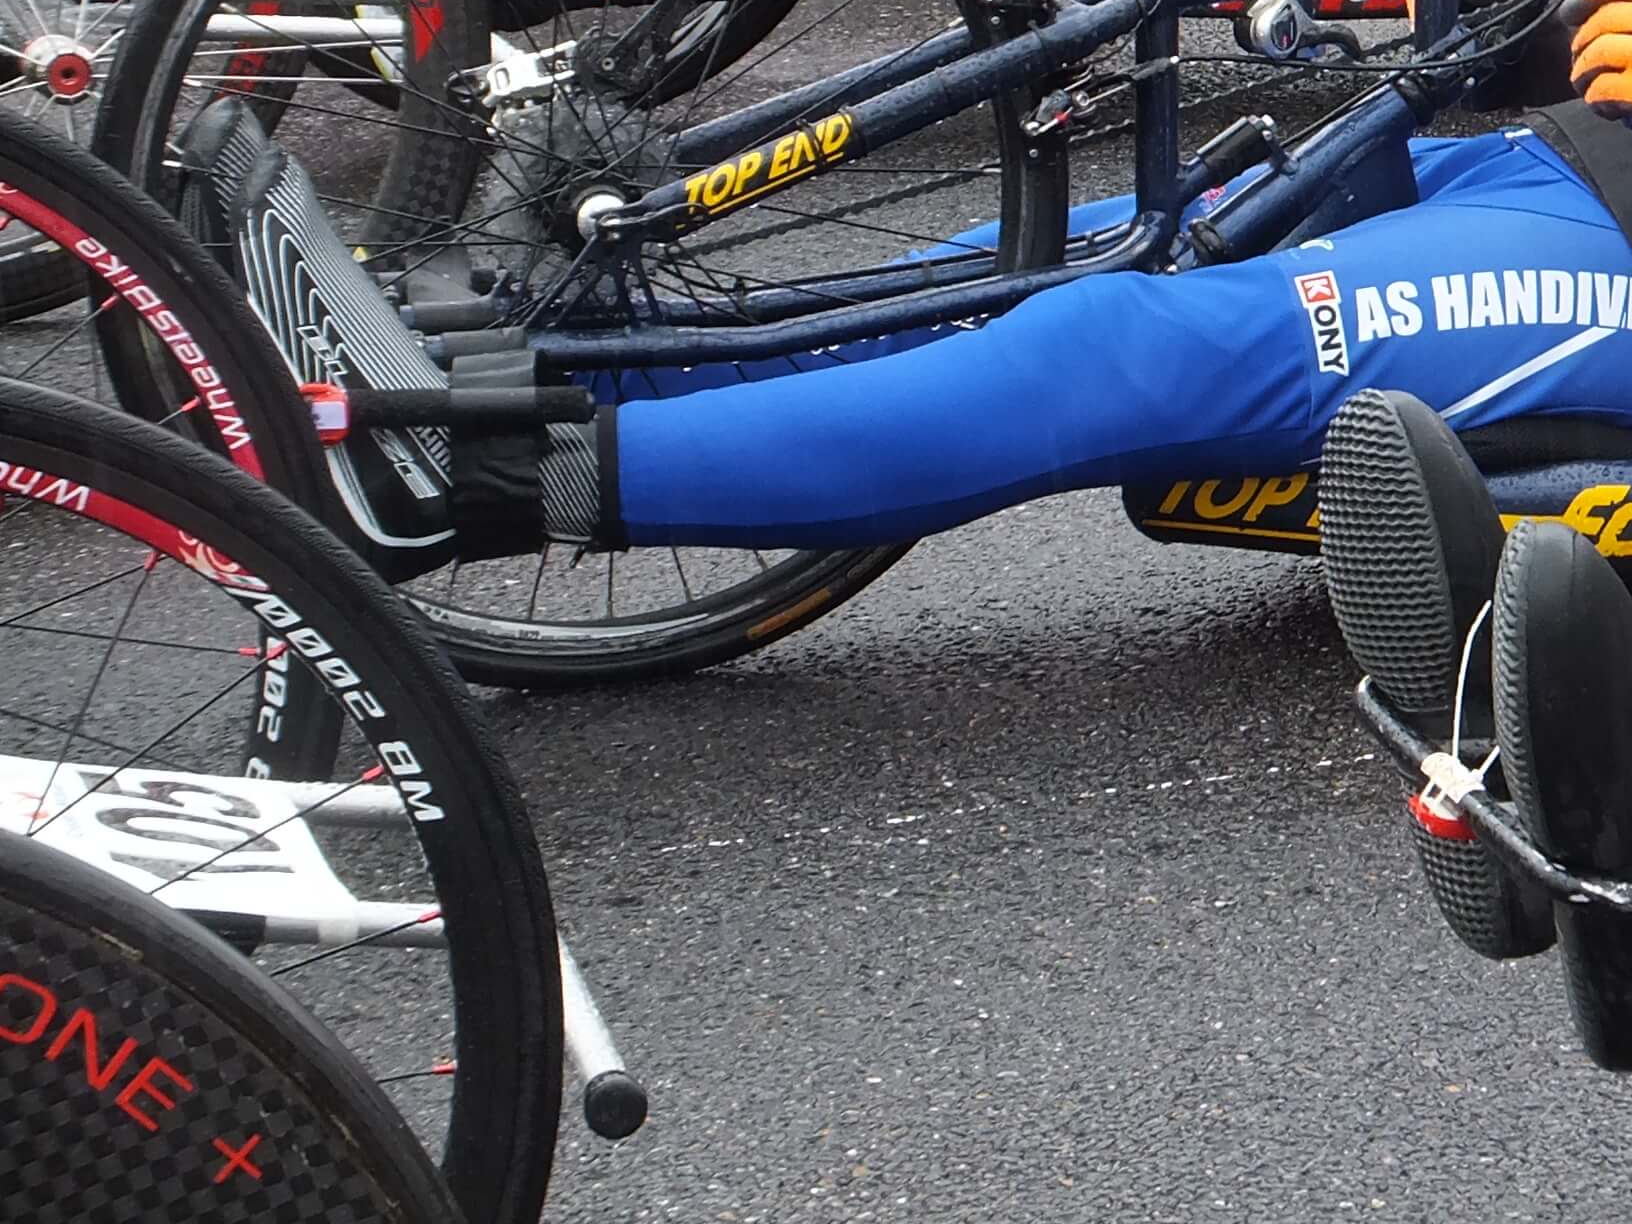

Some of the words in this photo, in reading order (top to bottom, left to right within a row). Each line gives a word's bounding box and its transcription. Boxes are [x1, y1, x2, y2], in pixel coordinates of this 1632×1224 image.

[685, 151, 763, 214] TOP
[768, 112, 853, 180] END
[1300, 276, 1346, 374] KONY
[1354, 280, 1424, 343] AS
